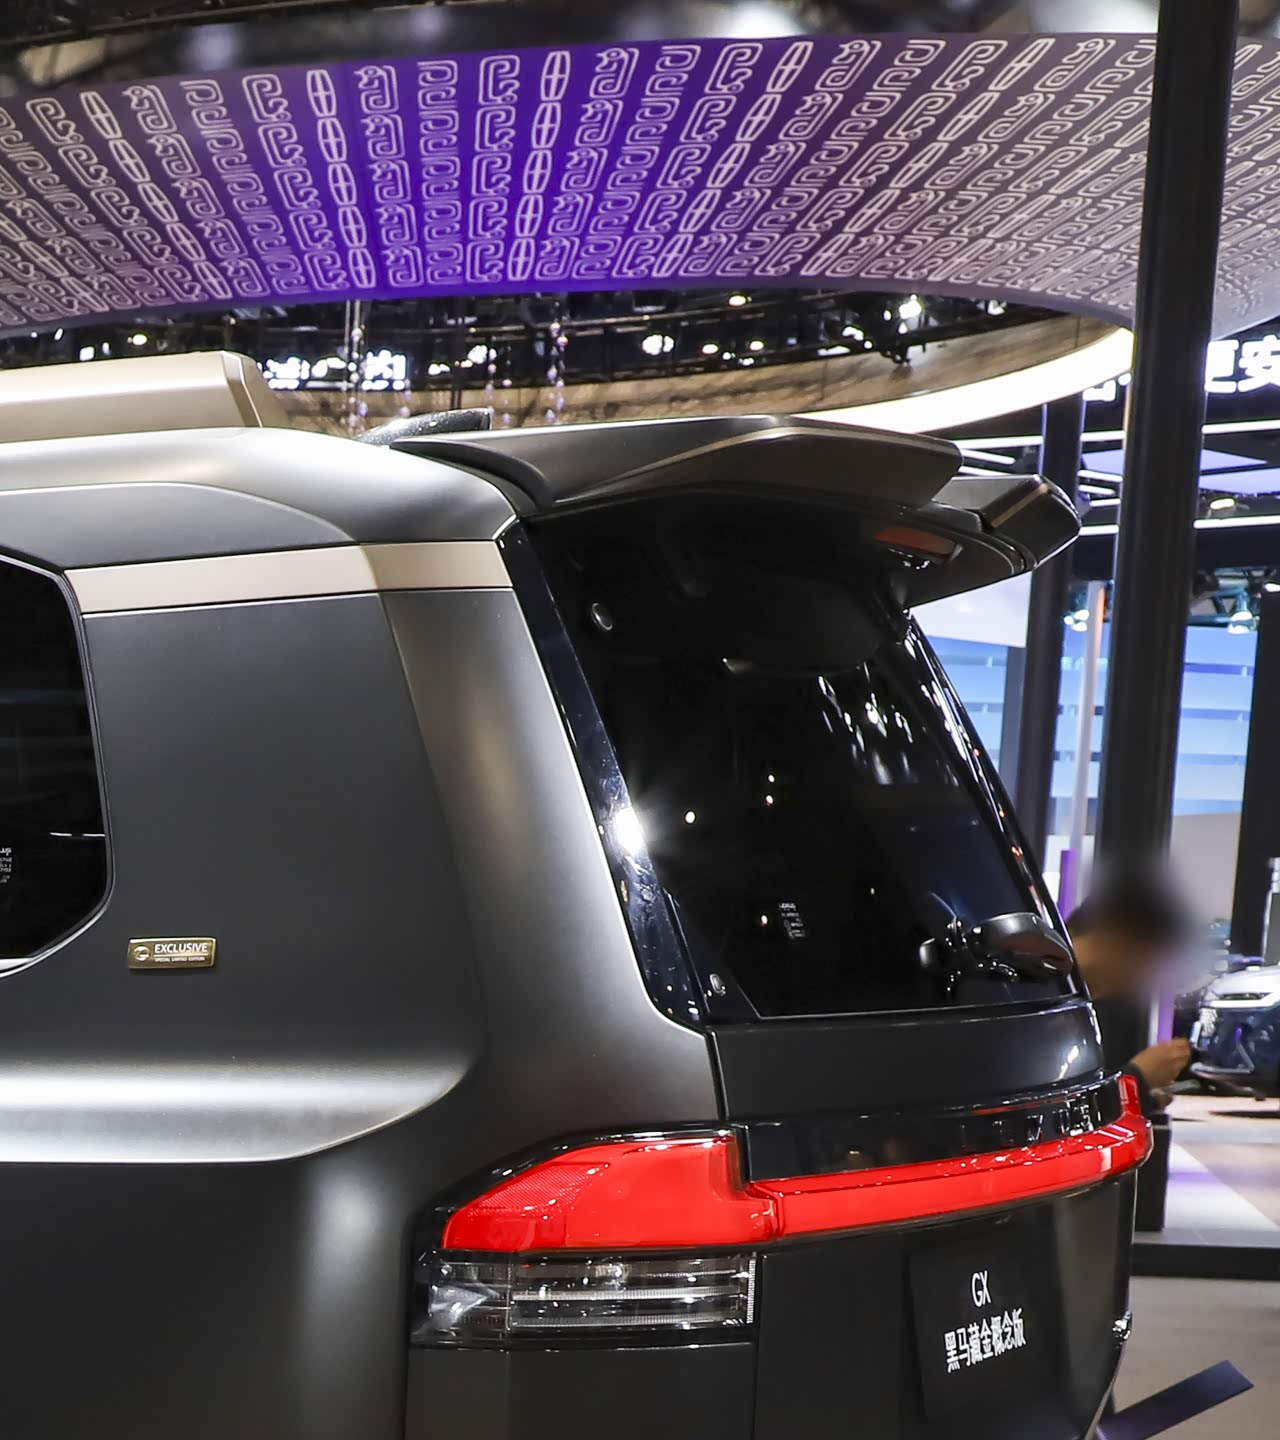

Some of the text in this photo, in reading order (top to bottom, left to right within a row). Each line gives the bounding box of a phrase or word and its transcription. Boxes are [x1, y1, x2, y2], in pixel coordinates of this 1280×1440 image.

[154, 942, 209, 954] EXCLUSIVE
[971, 1270, 991, 1308] GX
[944, 1307, 1027, 1374] 黑马藏金概念版
